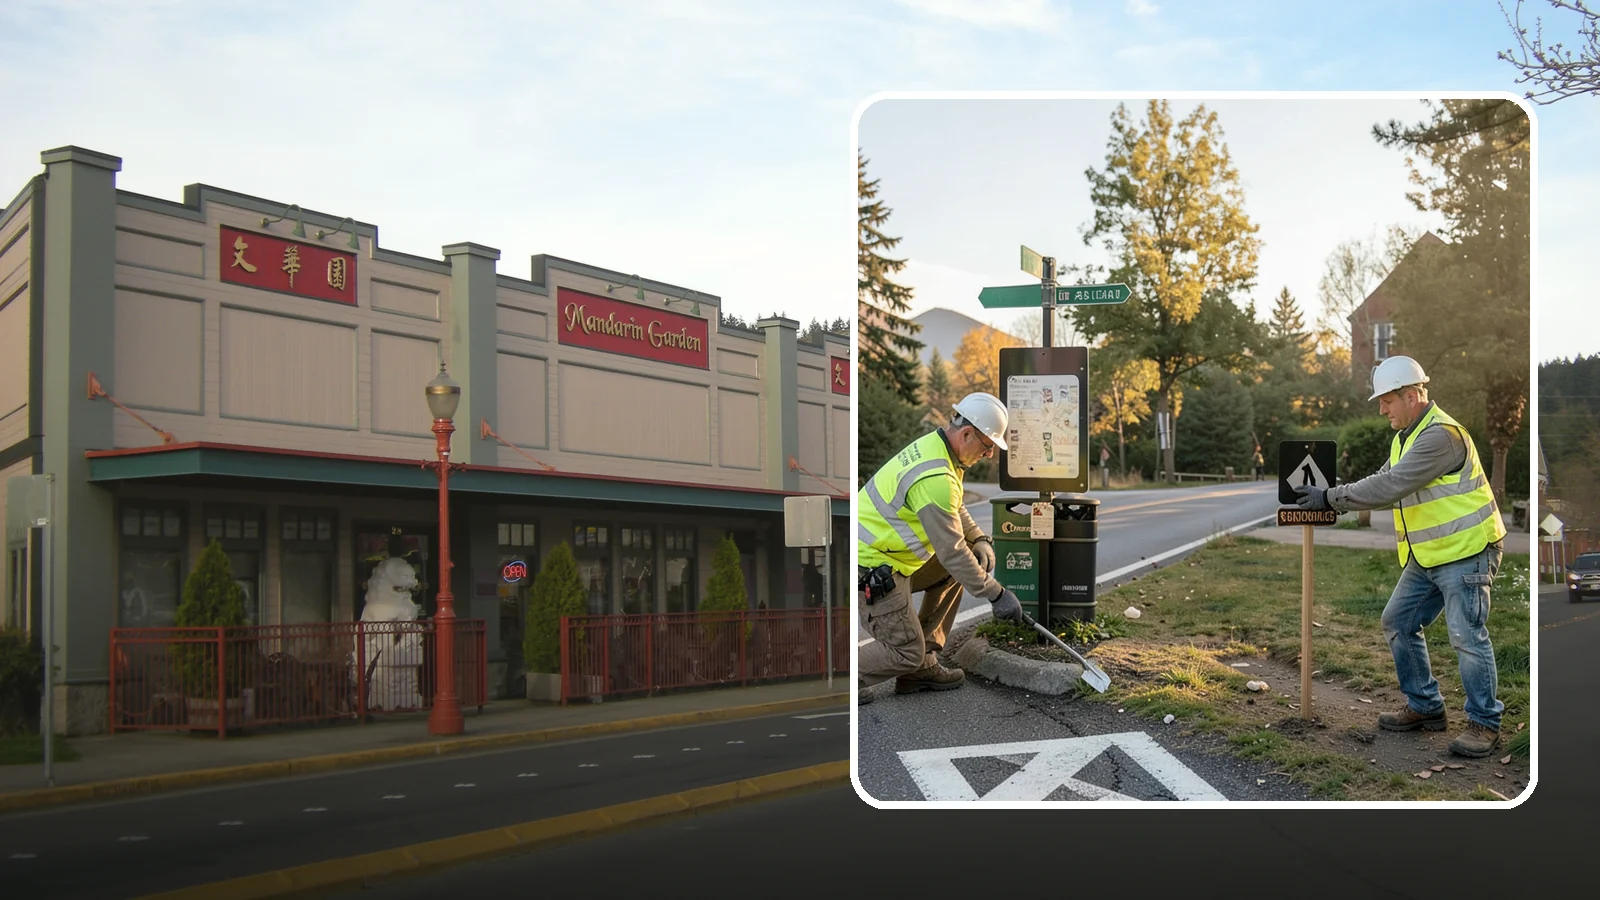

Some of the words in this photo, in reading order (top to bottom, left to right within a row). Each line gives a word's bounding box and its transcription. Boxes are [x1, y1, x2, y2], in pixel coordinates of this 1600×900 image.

[231, 236, 346, 290] 文華園
[564, 302, 644, 341] Mandarin
[648, 320, 701, 352] Garden
[503, 565, 527, 578] OPEN
